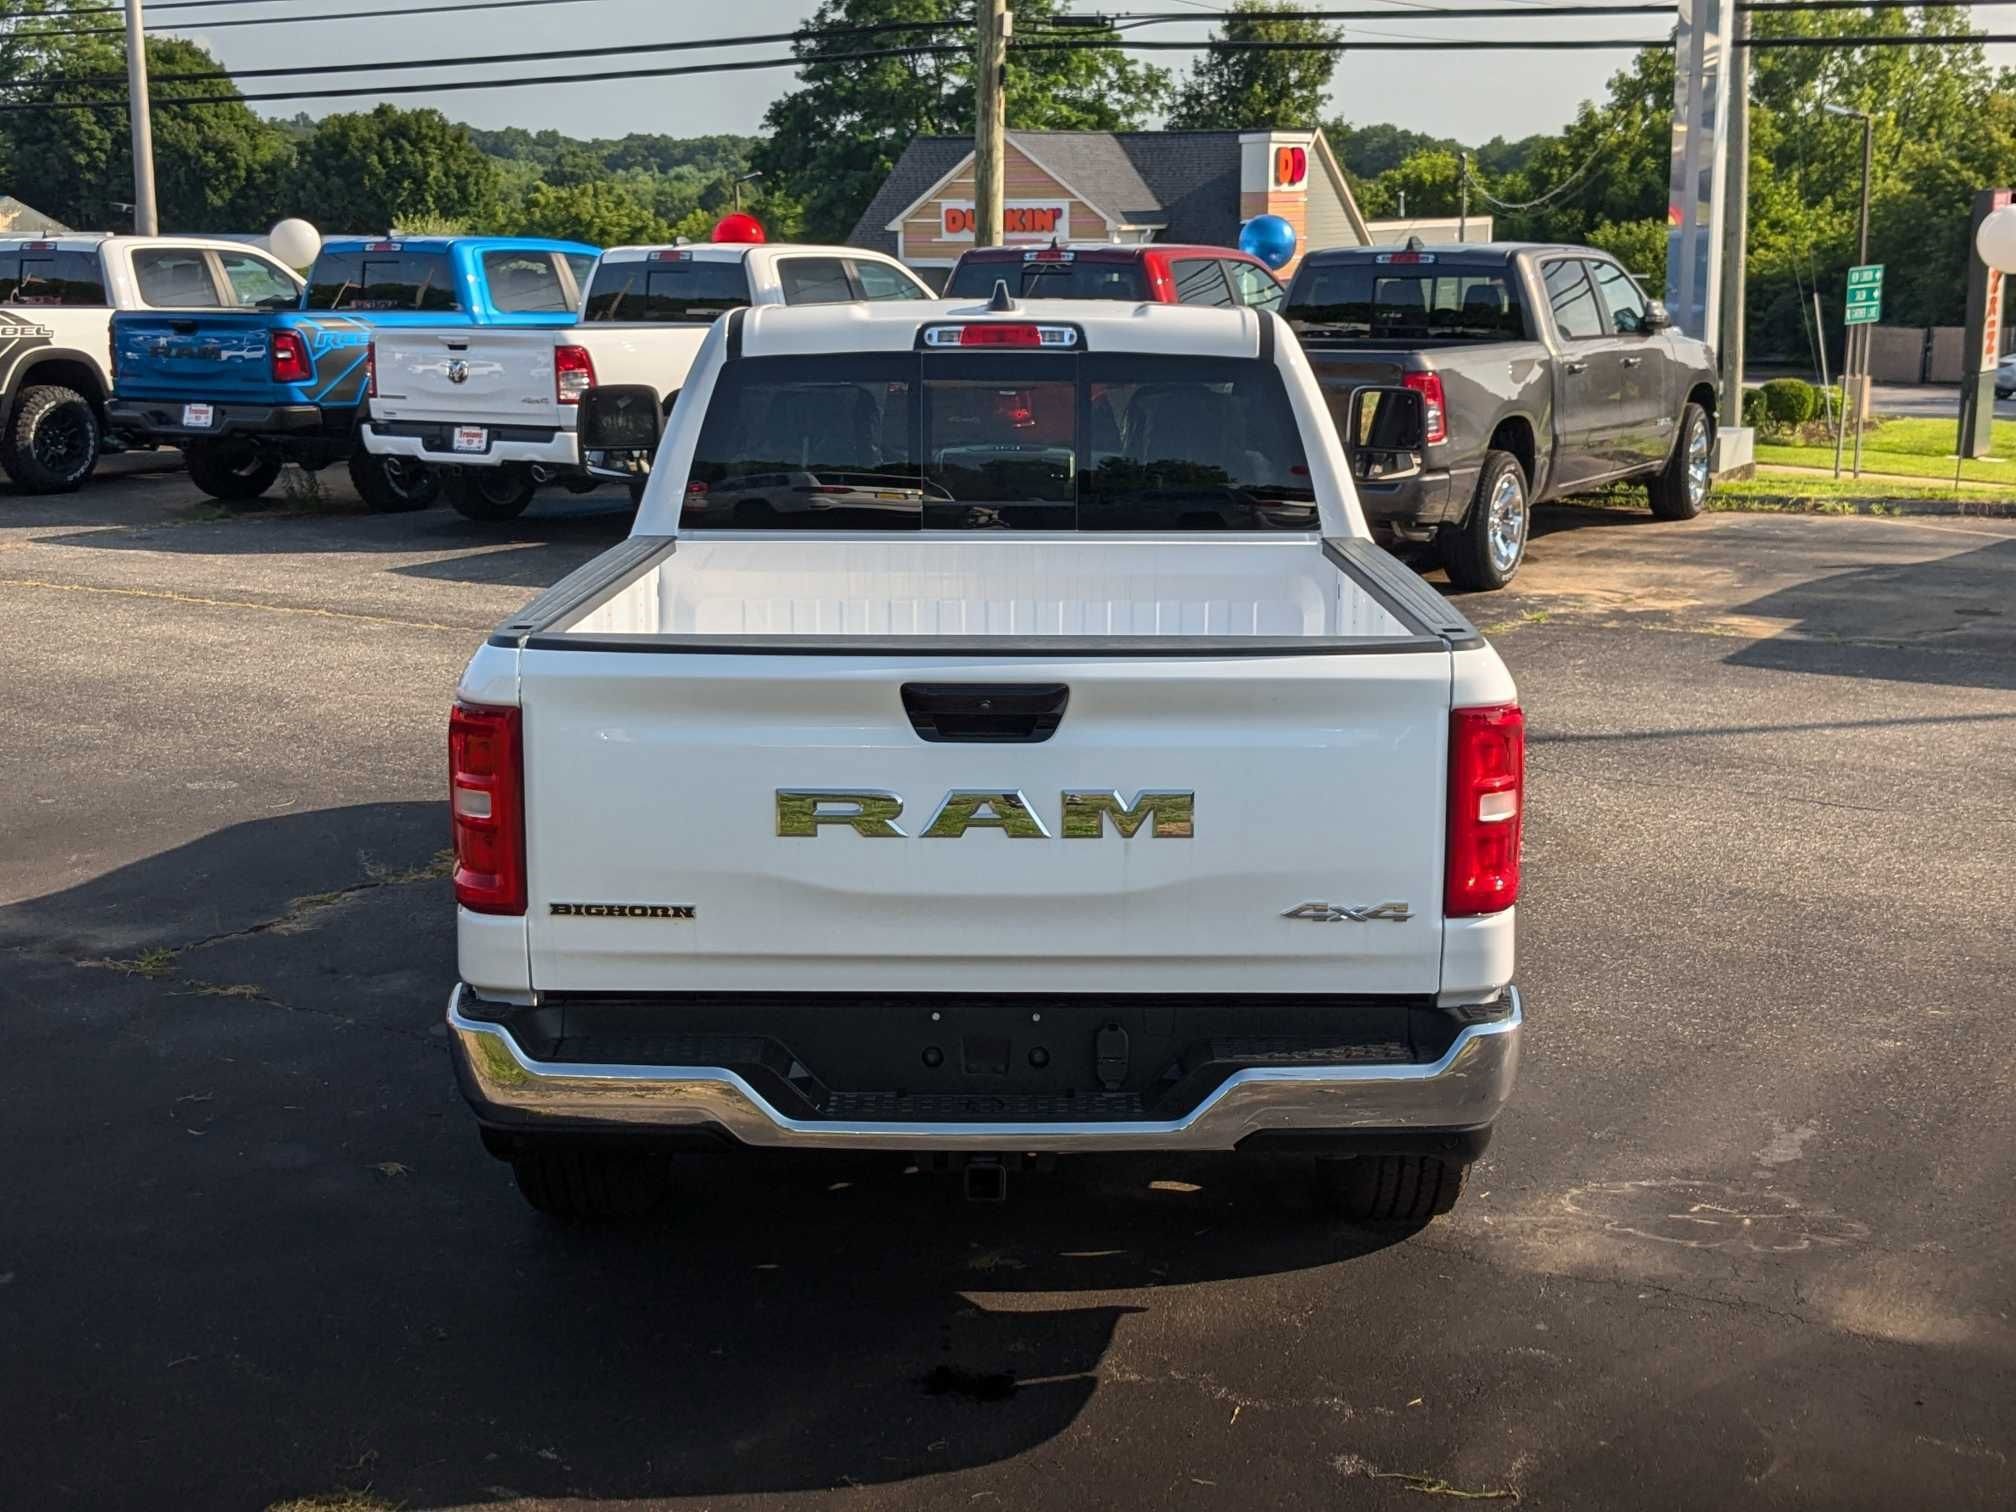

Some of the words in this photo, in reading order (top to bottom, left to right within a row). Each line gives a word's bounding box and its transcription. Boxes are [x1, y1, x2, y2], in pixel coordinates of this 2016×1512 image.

[1275, 147, 1305, 186] DD
[945, 207, 1063, 233] DUKIN'
[775, 788, 1195, 838] RAM
[549, 903, 695, 918] BIGHORN
[1279, 901, 1416, 922] 4x4
